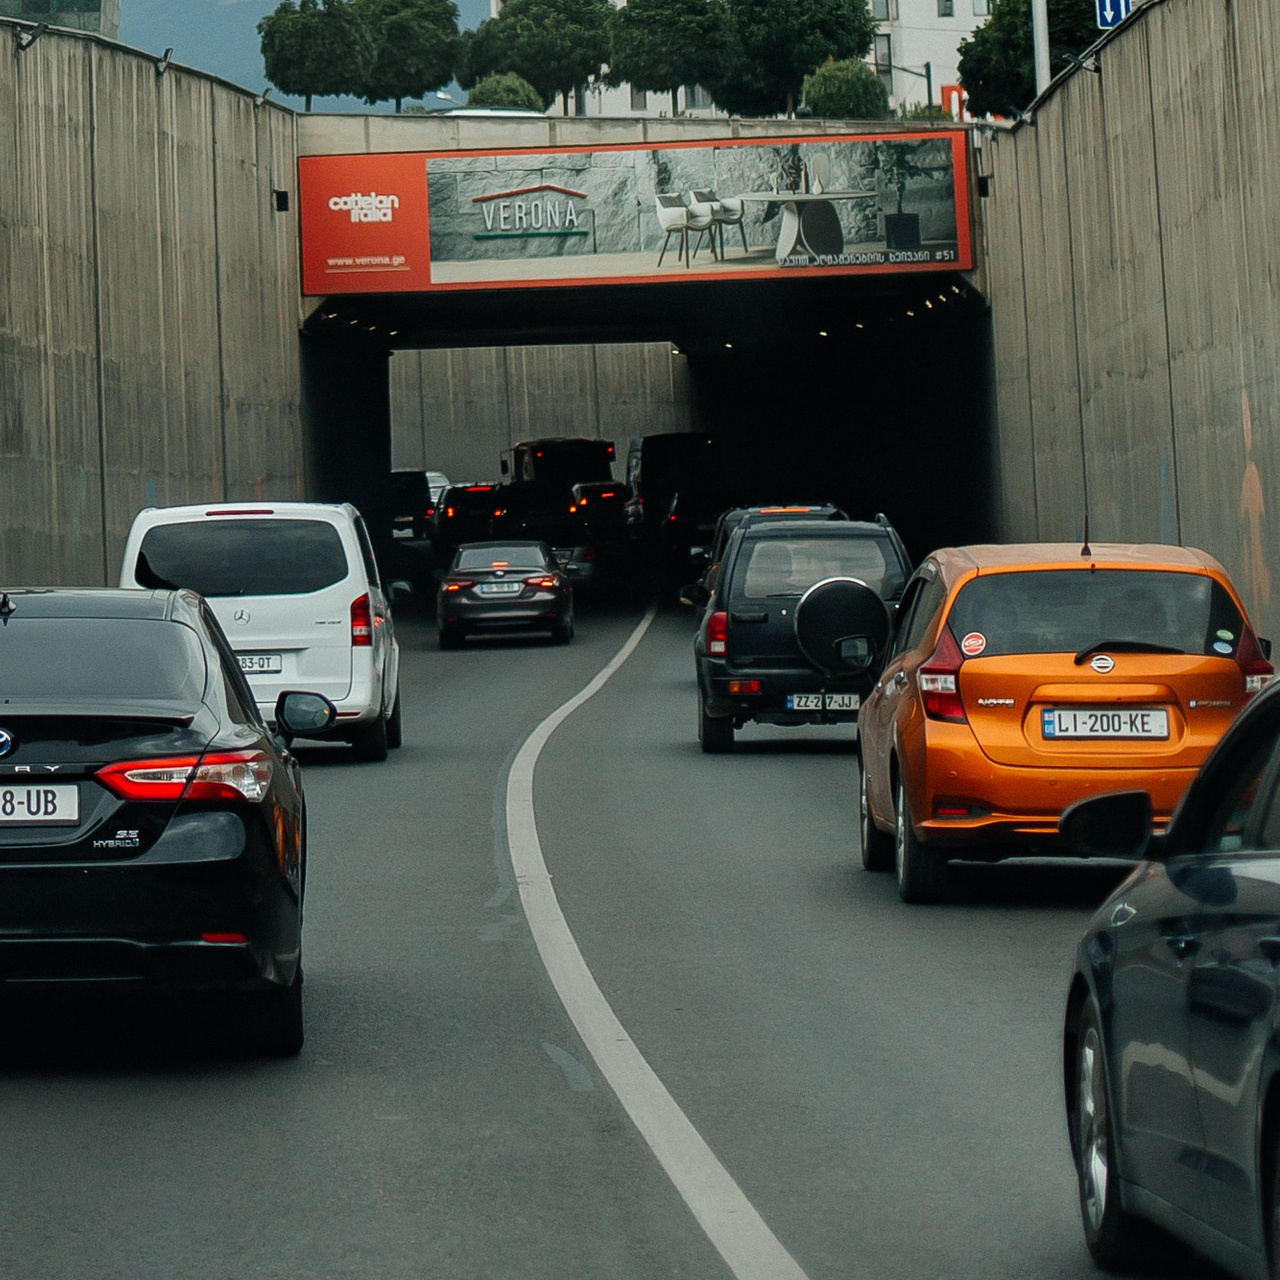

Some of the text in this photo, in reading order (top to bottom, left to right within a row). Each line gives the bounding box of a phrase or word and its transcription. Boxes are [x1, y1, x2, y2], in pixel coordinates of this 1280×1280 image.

[481, 200, 578, 231] VERONA
[326, 255, 406, 267] www.verona.ge
[935, 249, 955, 261] #51
[236, 657, 272, 670] 83-QT
[795, 695, 852, 708] ZZ-27-JJ
[1057, 712, 1152, 733] LI-200-KE
[93, 839, 132, 848] HYBRID
